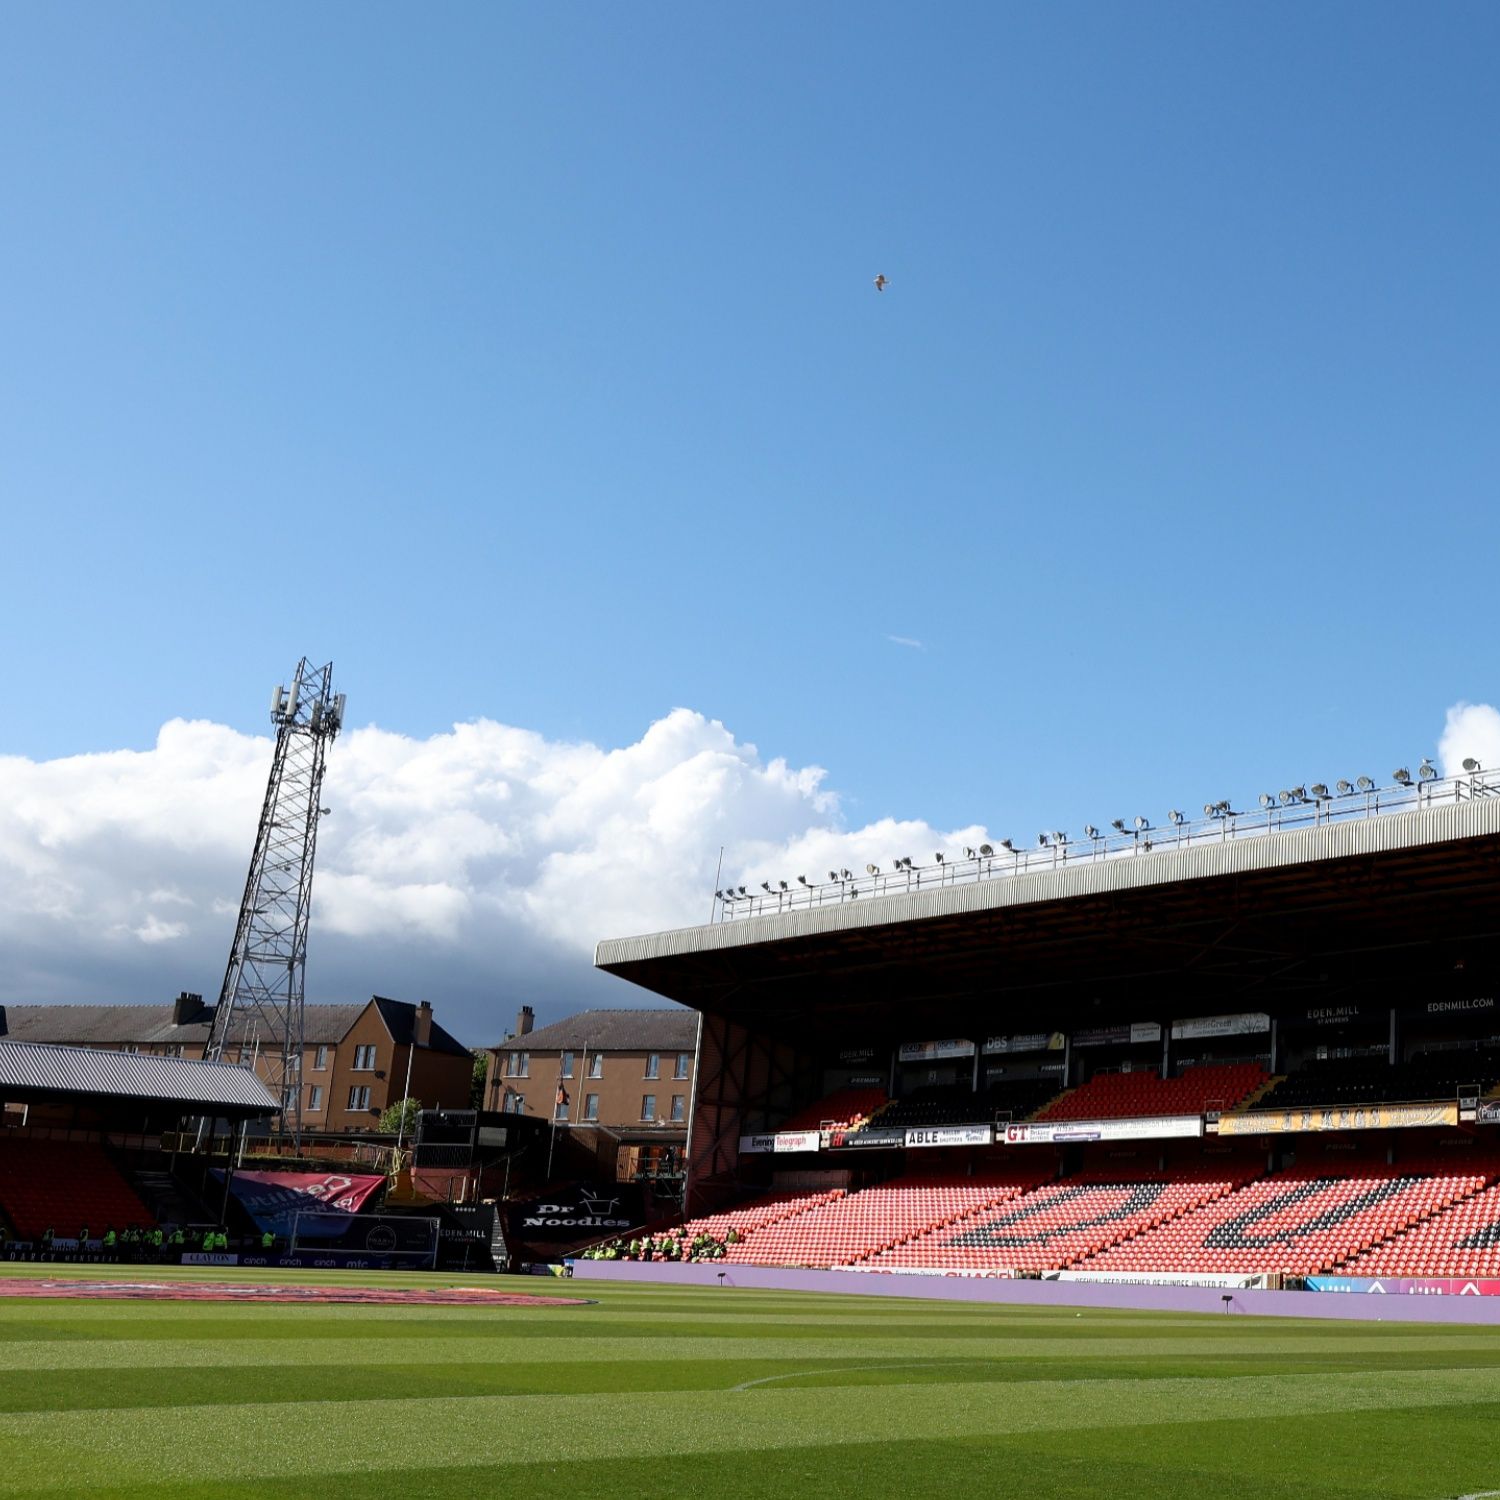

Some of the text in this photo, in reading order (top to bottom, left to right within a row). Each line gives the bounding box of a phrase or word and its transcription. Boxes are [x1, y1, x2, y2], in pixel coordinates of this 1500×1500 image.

[1427, 997, 1494, 1012] EDENMILL.COM
[1307, 1005, 1360, 1019] EDEN.MILL
[987, 1036, 1008, 1048] DBS
[909, 1131, 939, 1145] ABLE
[1007, 1125, 1029, 1141] GT
[777, 1136, 807, 1147] Telegraph
[536, 1204, 575, 1214] Dr
[522, 1216, 631, 1227] Noodles
[243, 1256, 268, 1266] cinch
[279, 1256, 303, 1267] cinch
[313, 1257, 336, 1268] cinch
